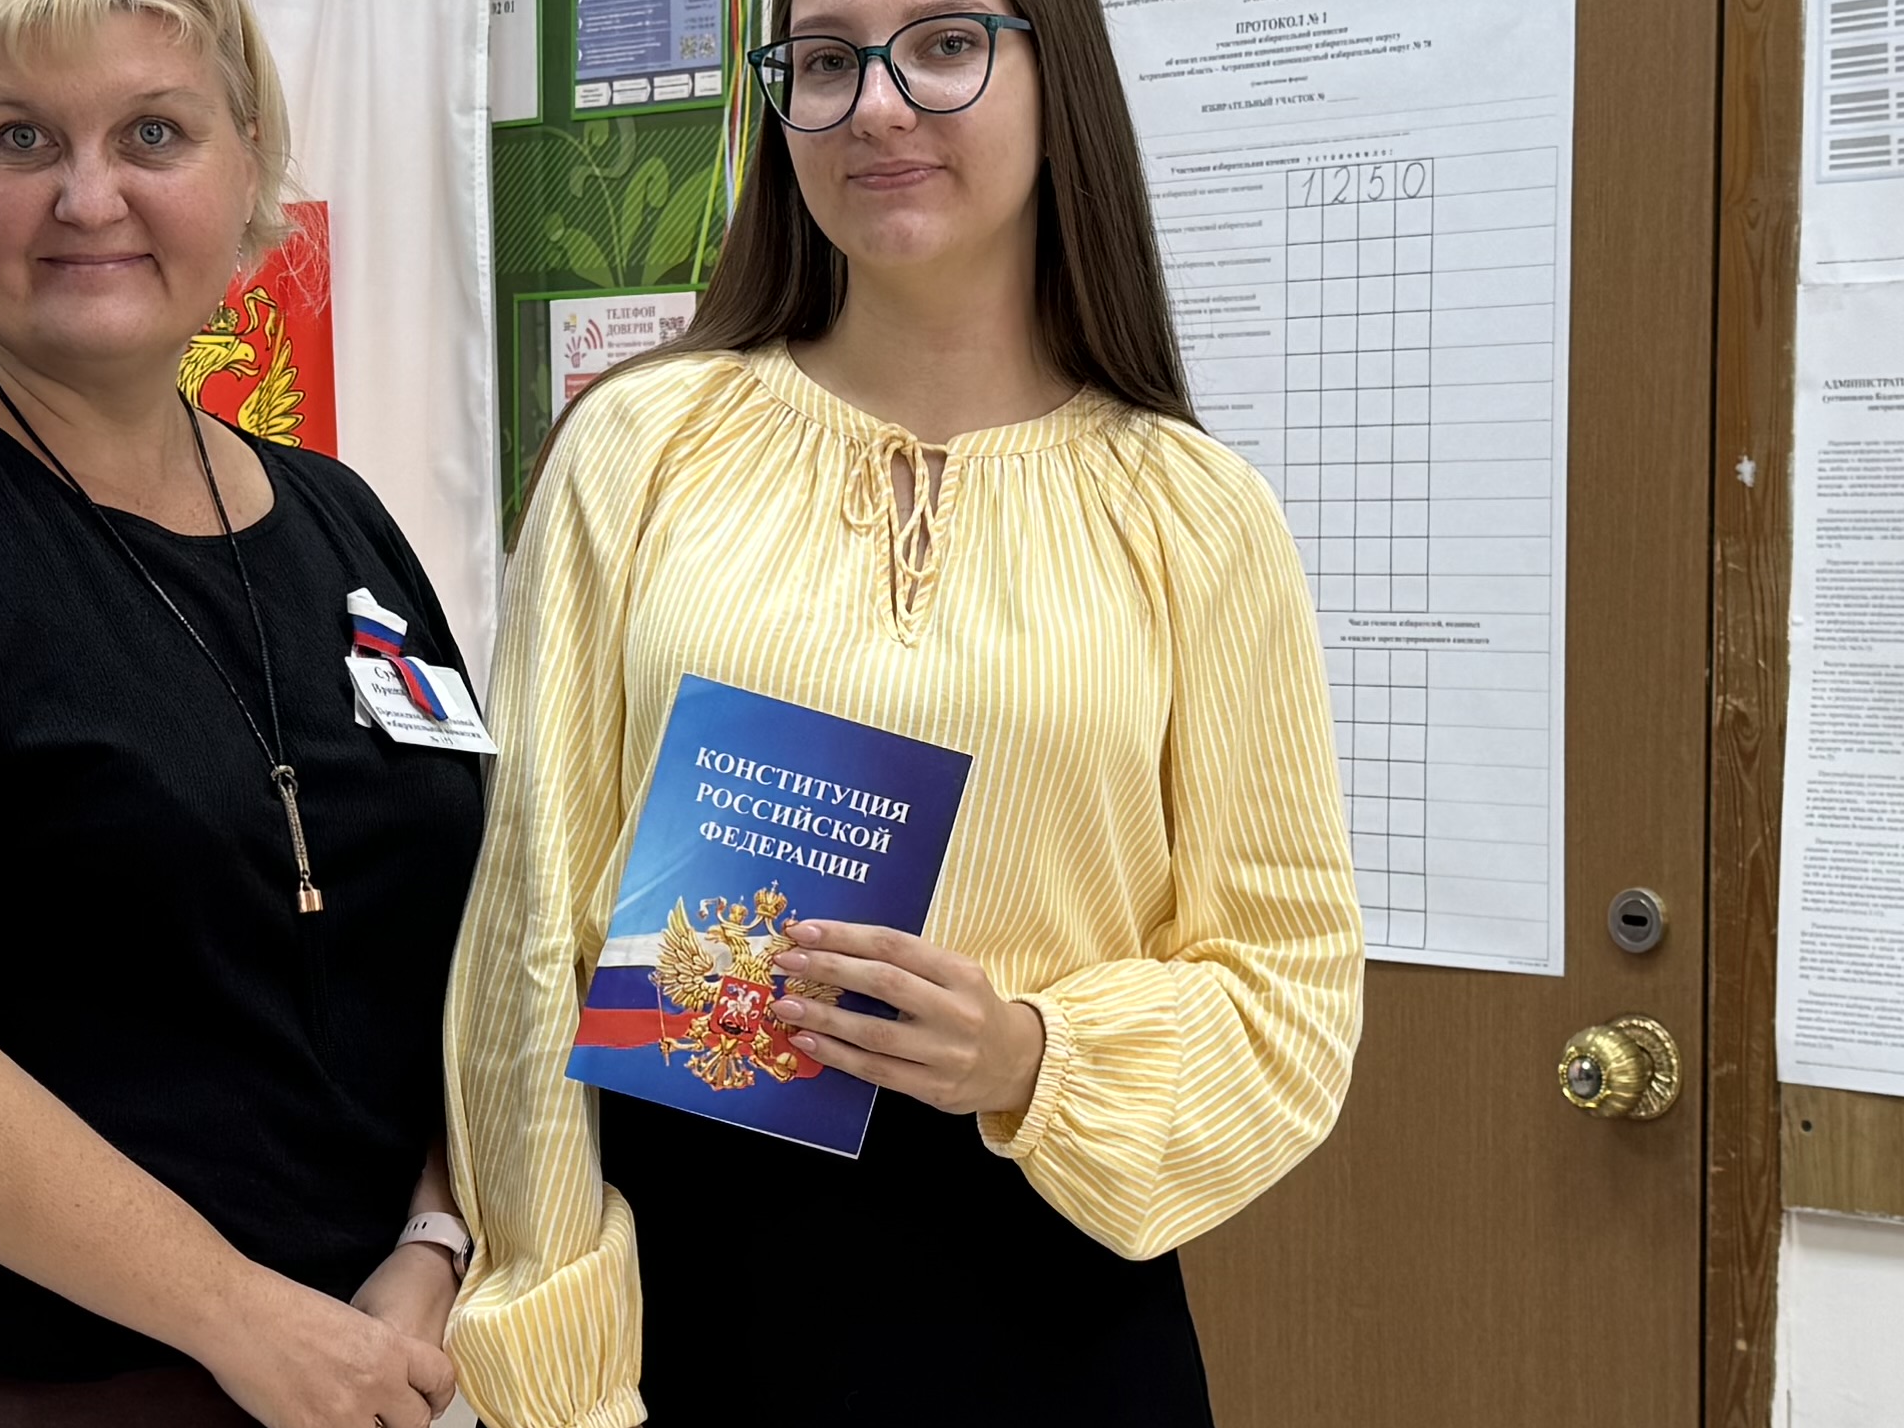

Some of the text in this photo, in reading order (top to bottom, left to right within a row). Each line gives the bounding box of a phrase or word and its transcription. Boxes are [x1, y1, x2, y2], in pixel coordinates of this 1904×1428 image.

[1236, 14, 1304, 34] ПРОТОКОЛ
[606, 306, 656, 320] ТЕЛЕФОН
[606, 323, 653, 337] ДОВЕРИЯ
[696, 746, 911, 825] КОНСТИТУЦИЯ
[696, 781, 892, 854] РОССИЙСКОЙ
[699, 819, 870, 884] ФЕДЕРАЦИИ
